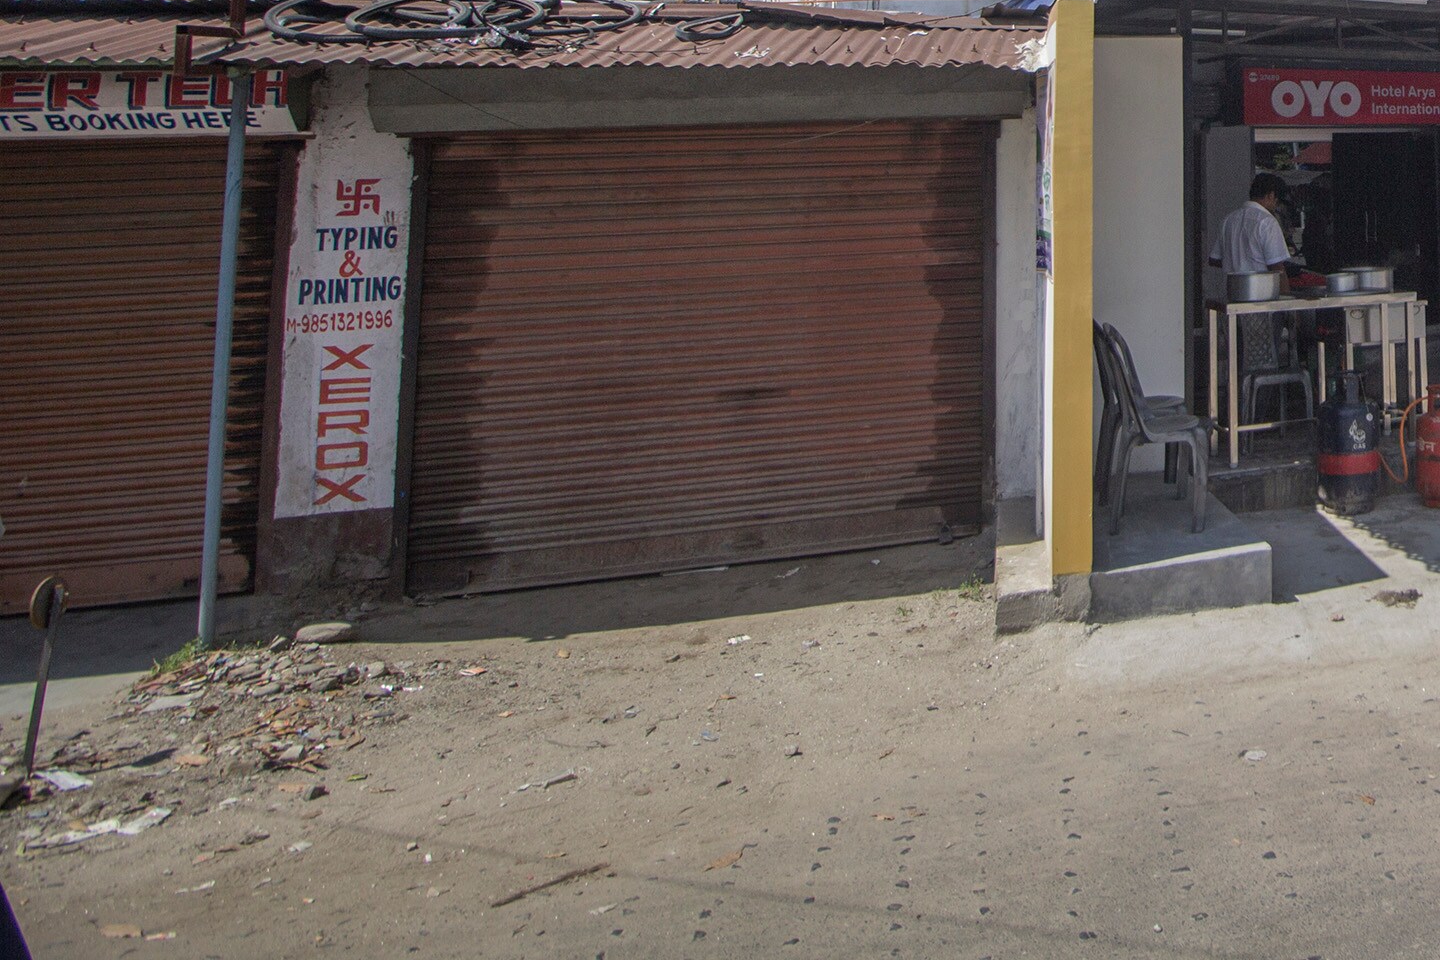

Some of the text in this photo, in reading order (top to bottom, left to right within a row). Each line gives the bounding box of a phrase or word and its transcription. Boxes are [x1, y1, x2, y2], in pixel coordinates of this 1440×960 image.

[1271, 80, 1362, 118] OYO
[1371, 85, 1436, 100] Hotel Arya
[44, 111, 176, 132] BOOKING
[181, 110, 261, 129] HEE
[316, 226, 398, 251] TYPING
[339, 250, 363, 278] &
[298, 276, 401, 305] PRINTING
[287, 310, 393, 333] M-9851321996
[312, 343, 375, 506] XEROX
